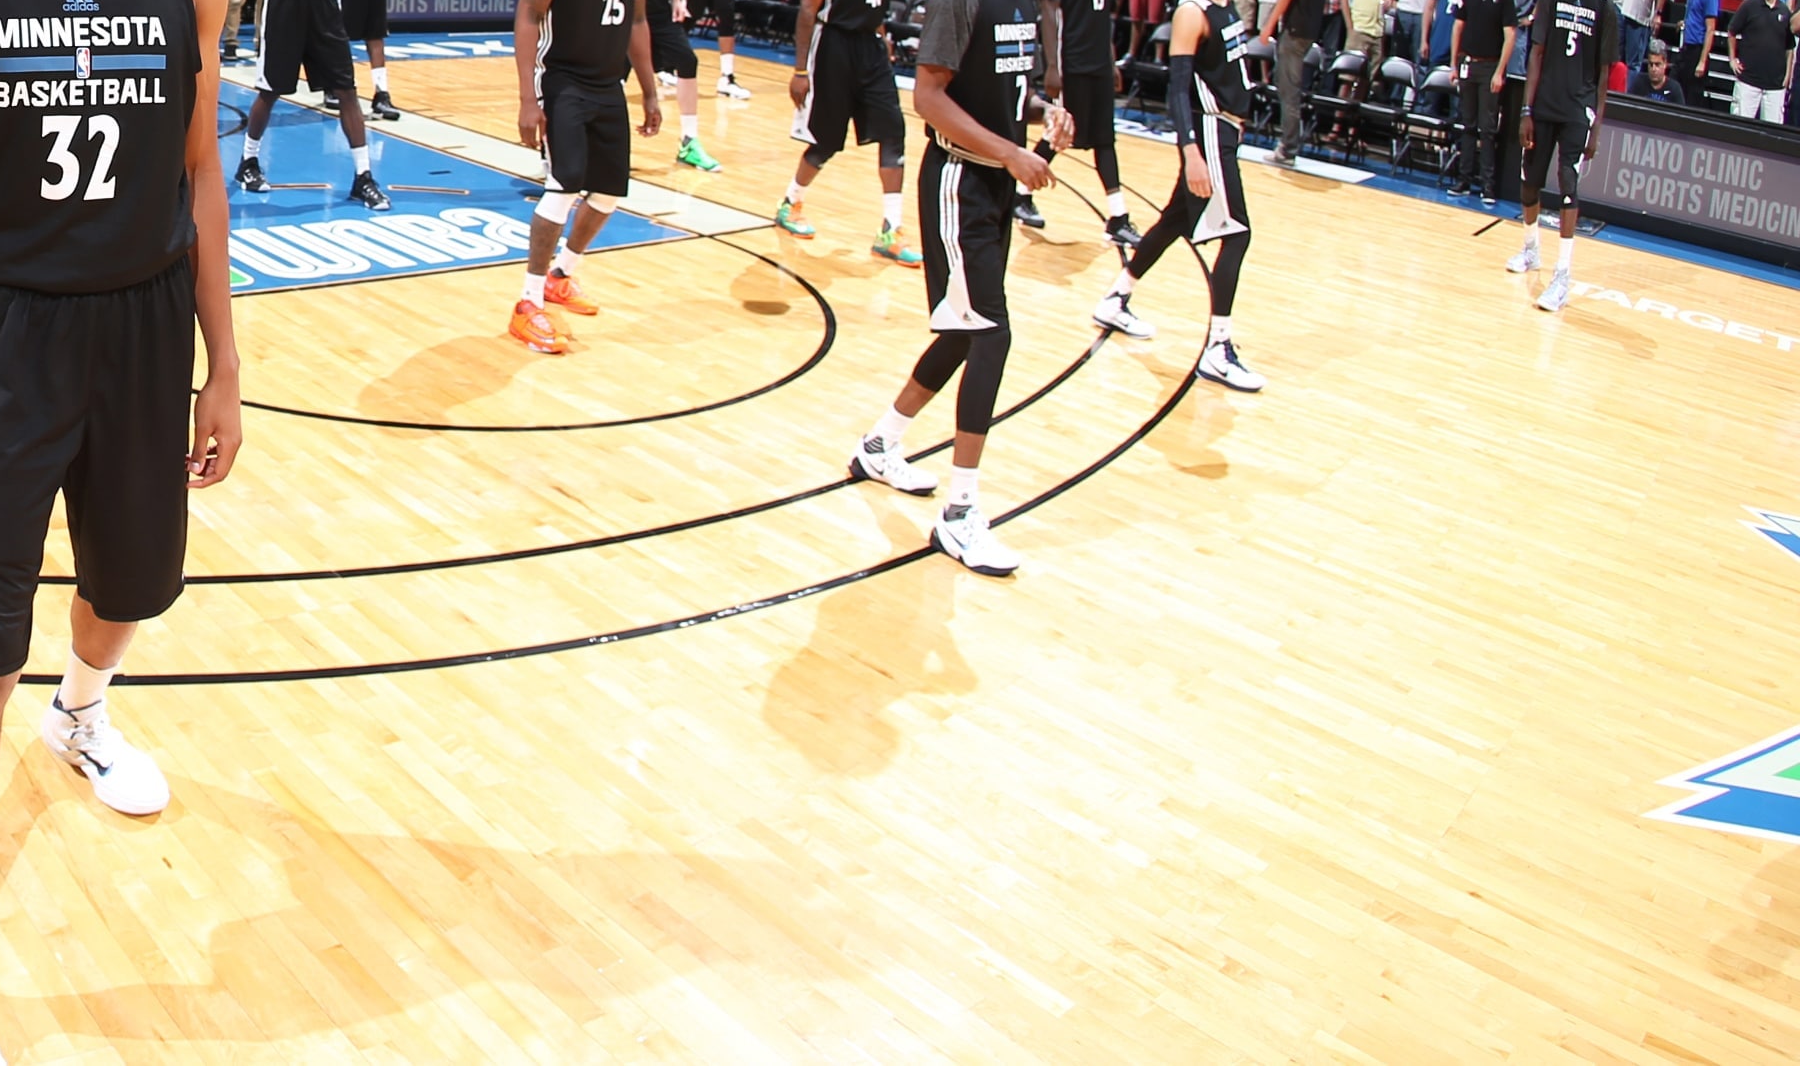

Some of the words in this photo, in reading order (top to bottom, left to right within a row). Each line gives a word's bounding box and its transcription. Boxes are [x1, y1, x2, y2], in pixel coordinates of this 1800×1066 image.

[62, 1, 100, 12] adidas
[1556, 2, 1596, 20] MINNESOTA
[1555, 18, 1593, 37] BASKETBALL
[1565, 32, 1578, 57] 5
[40, 114, 121, 201] 32
[1620, 133, 1684, 174] MAYO
[1689, 148, 1765, 192] CLINIC
[1615, 168, 1703, 215] SPORTS
[1570, 280, 1800, 352] TARGET
